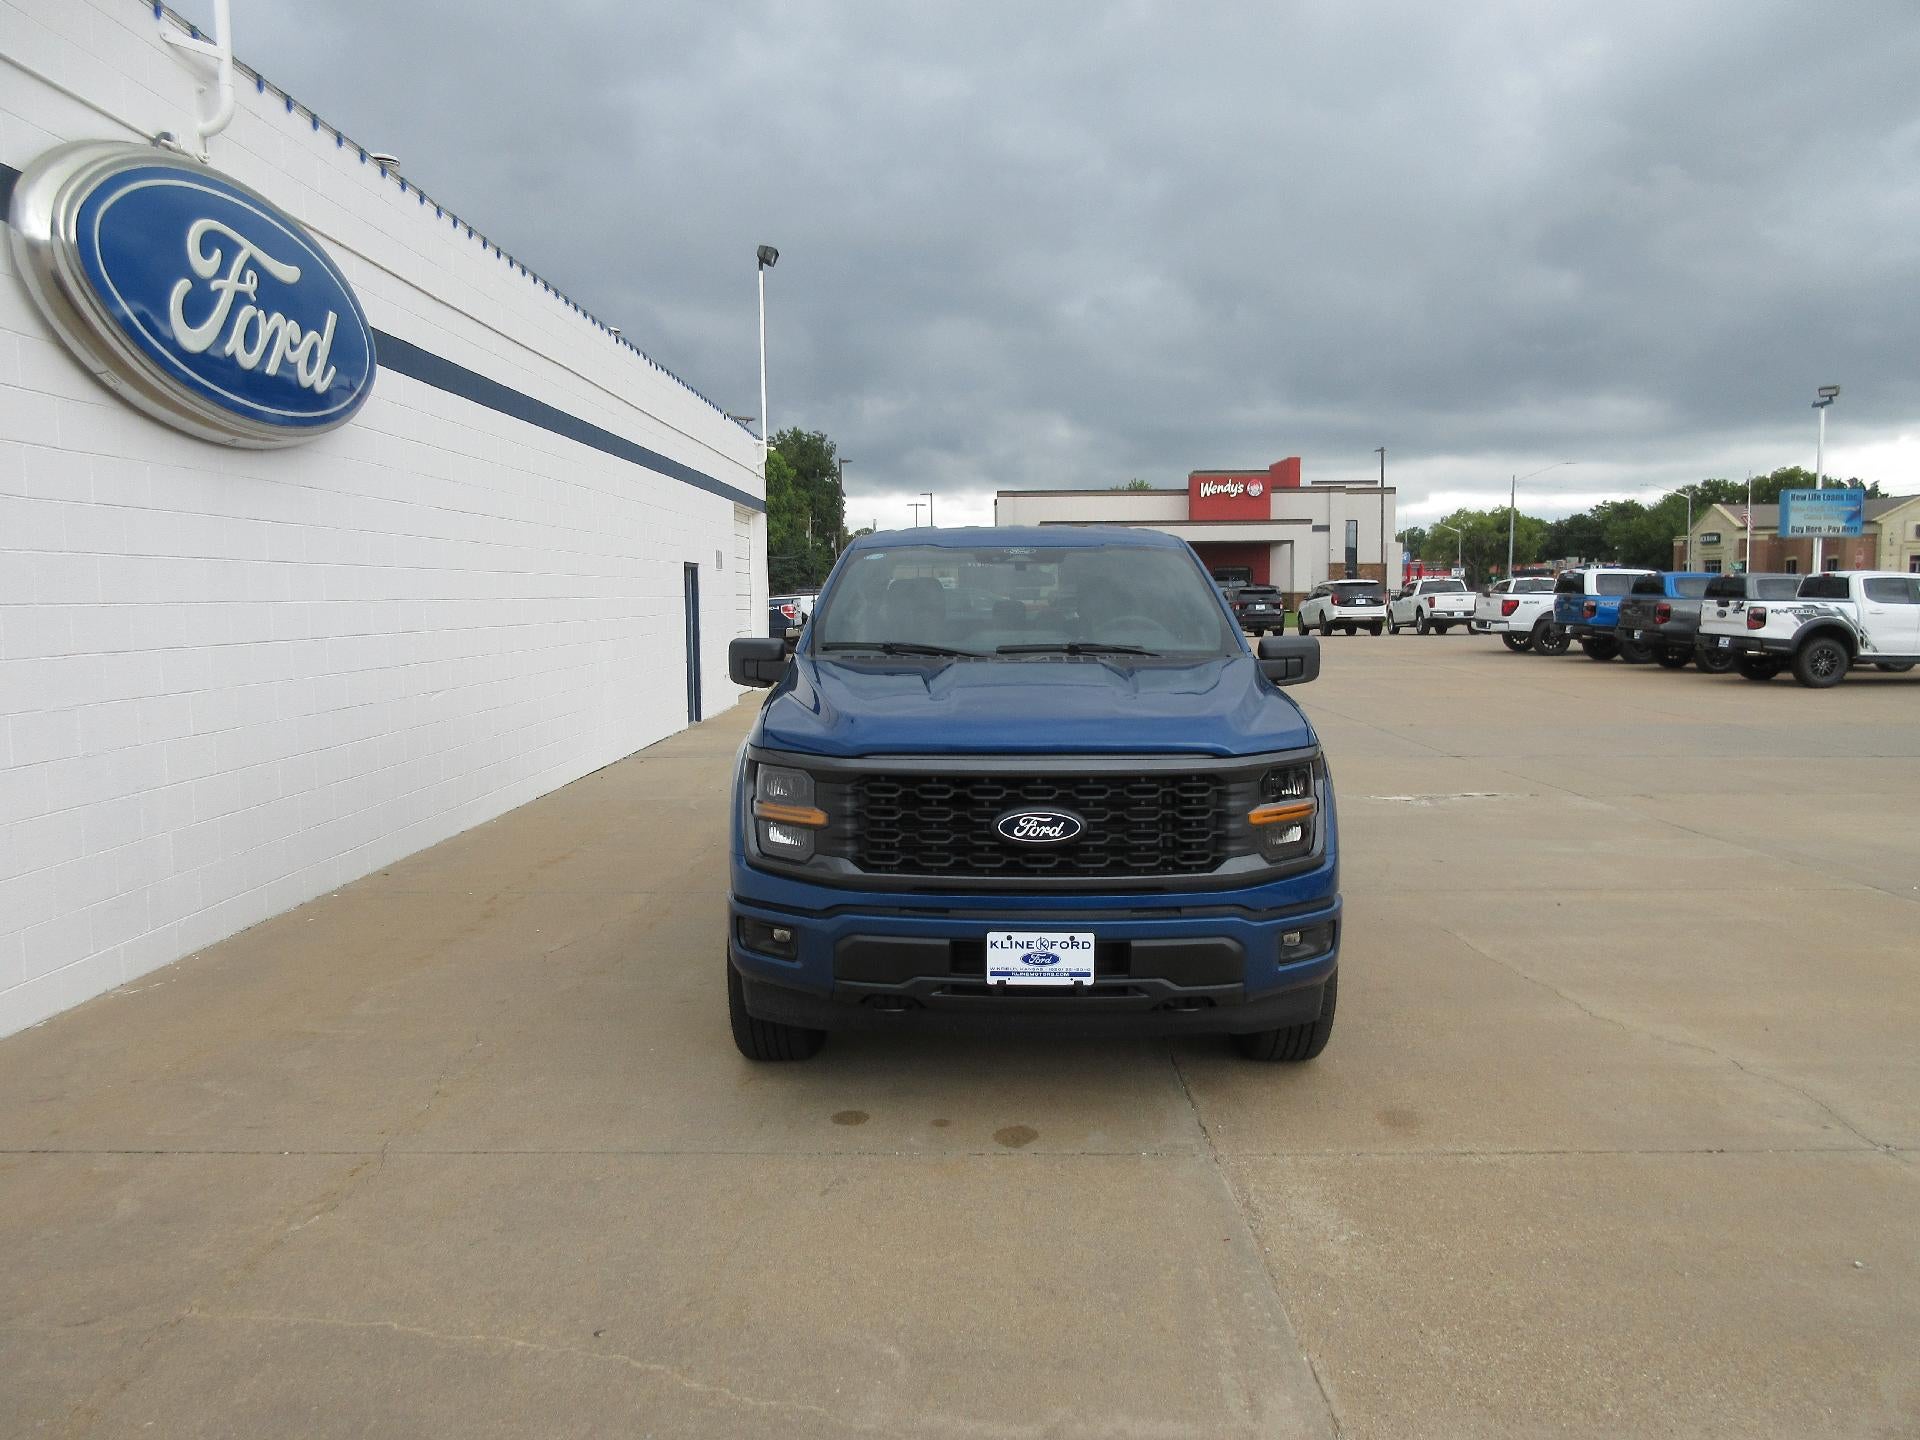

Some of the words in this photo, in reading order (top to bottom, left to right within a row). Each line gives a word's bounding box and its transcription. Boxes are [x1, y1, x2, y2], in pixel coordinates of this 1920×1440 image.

[169, 218, 338, 394] Ford
[1200, 478, 1245, 498] Wendy's
[1791, 493, 1807, 501] New
[1790, 525, 1805, 534] Buy
[1806, 525, 1822, 533] Here
[1828, 525, 1841, 534] Pay
[1013, 816, 1065, 837] Ford
[990, 940, 1035, 950] KLINE
[1050, 941, 1091, 950] FORD
[1028, 953, 1053, 965] Ford
